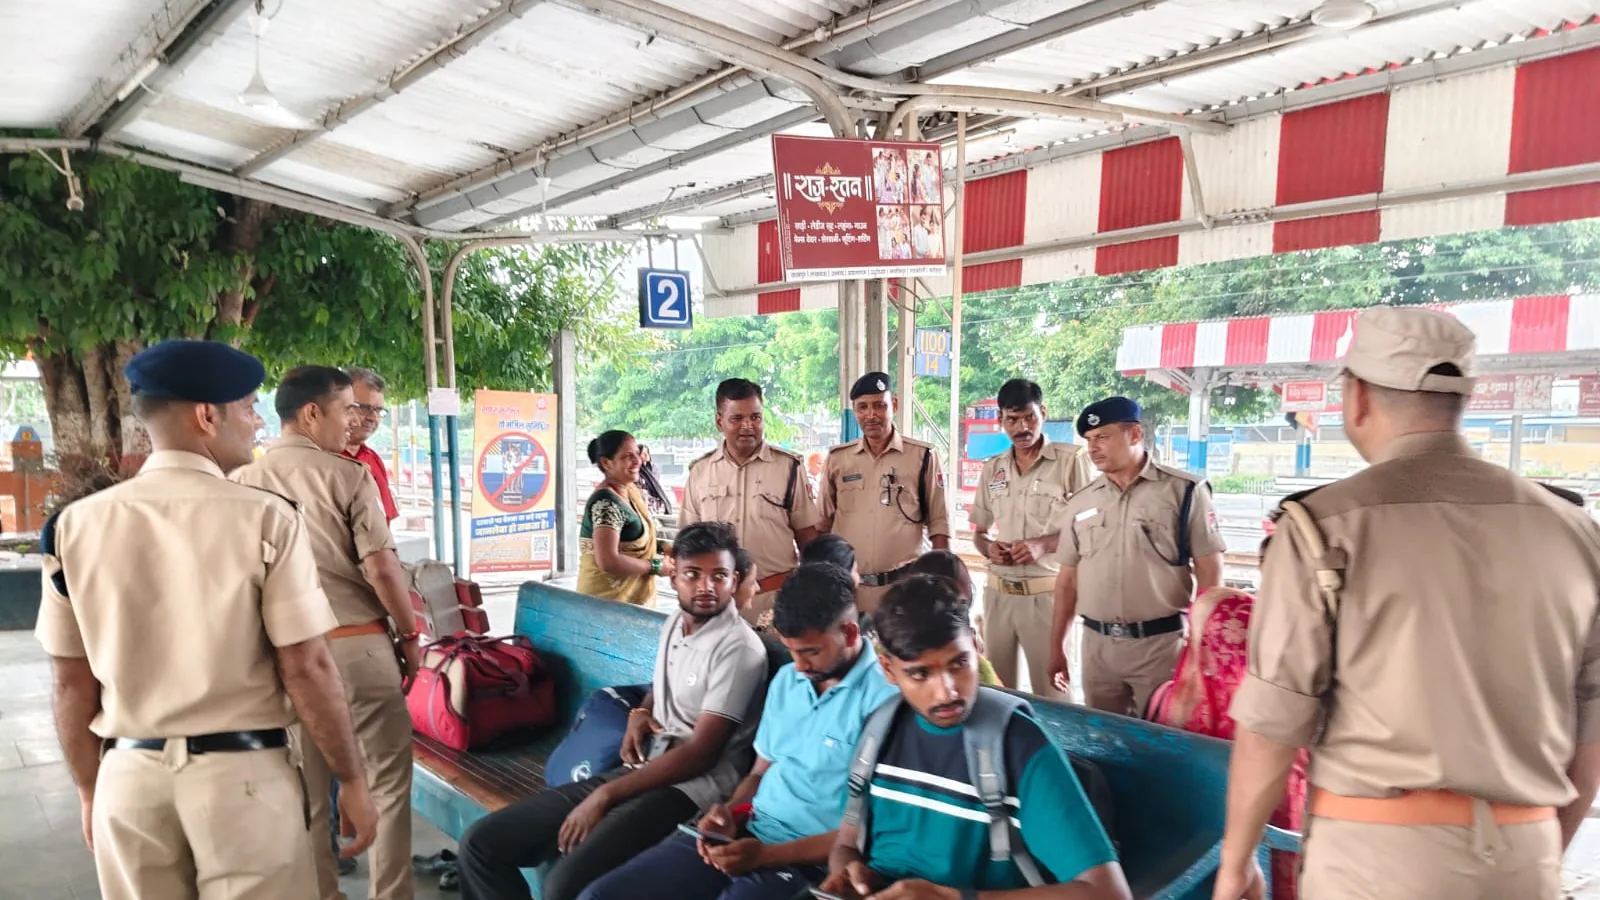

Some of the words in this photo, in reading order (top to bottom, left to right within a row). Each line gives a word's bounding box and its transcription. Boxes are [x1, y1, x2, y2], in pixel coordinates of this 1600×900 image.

[794, 174, 862, 202] राज-रतन
[657, 279, 680, 318] 2
[920, 331, 946, 352] 1100
[925, 354, 938, 375] 14
